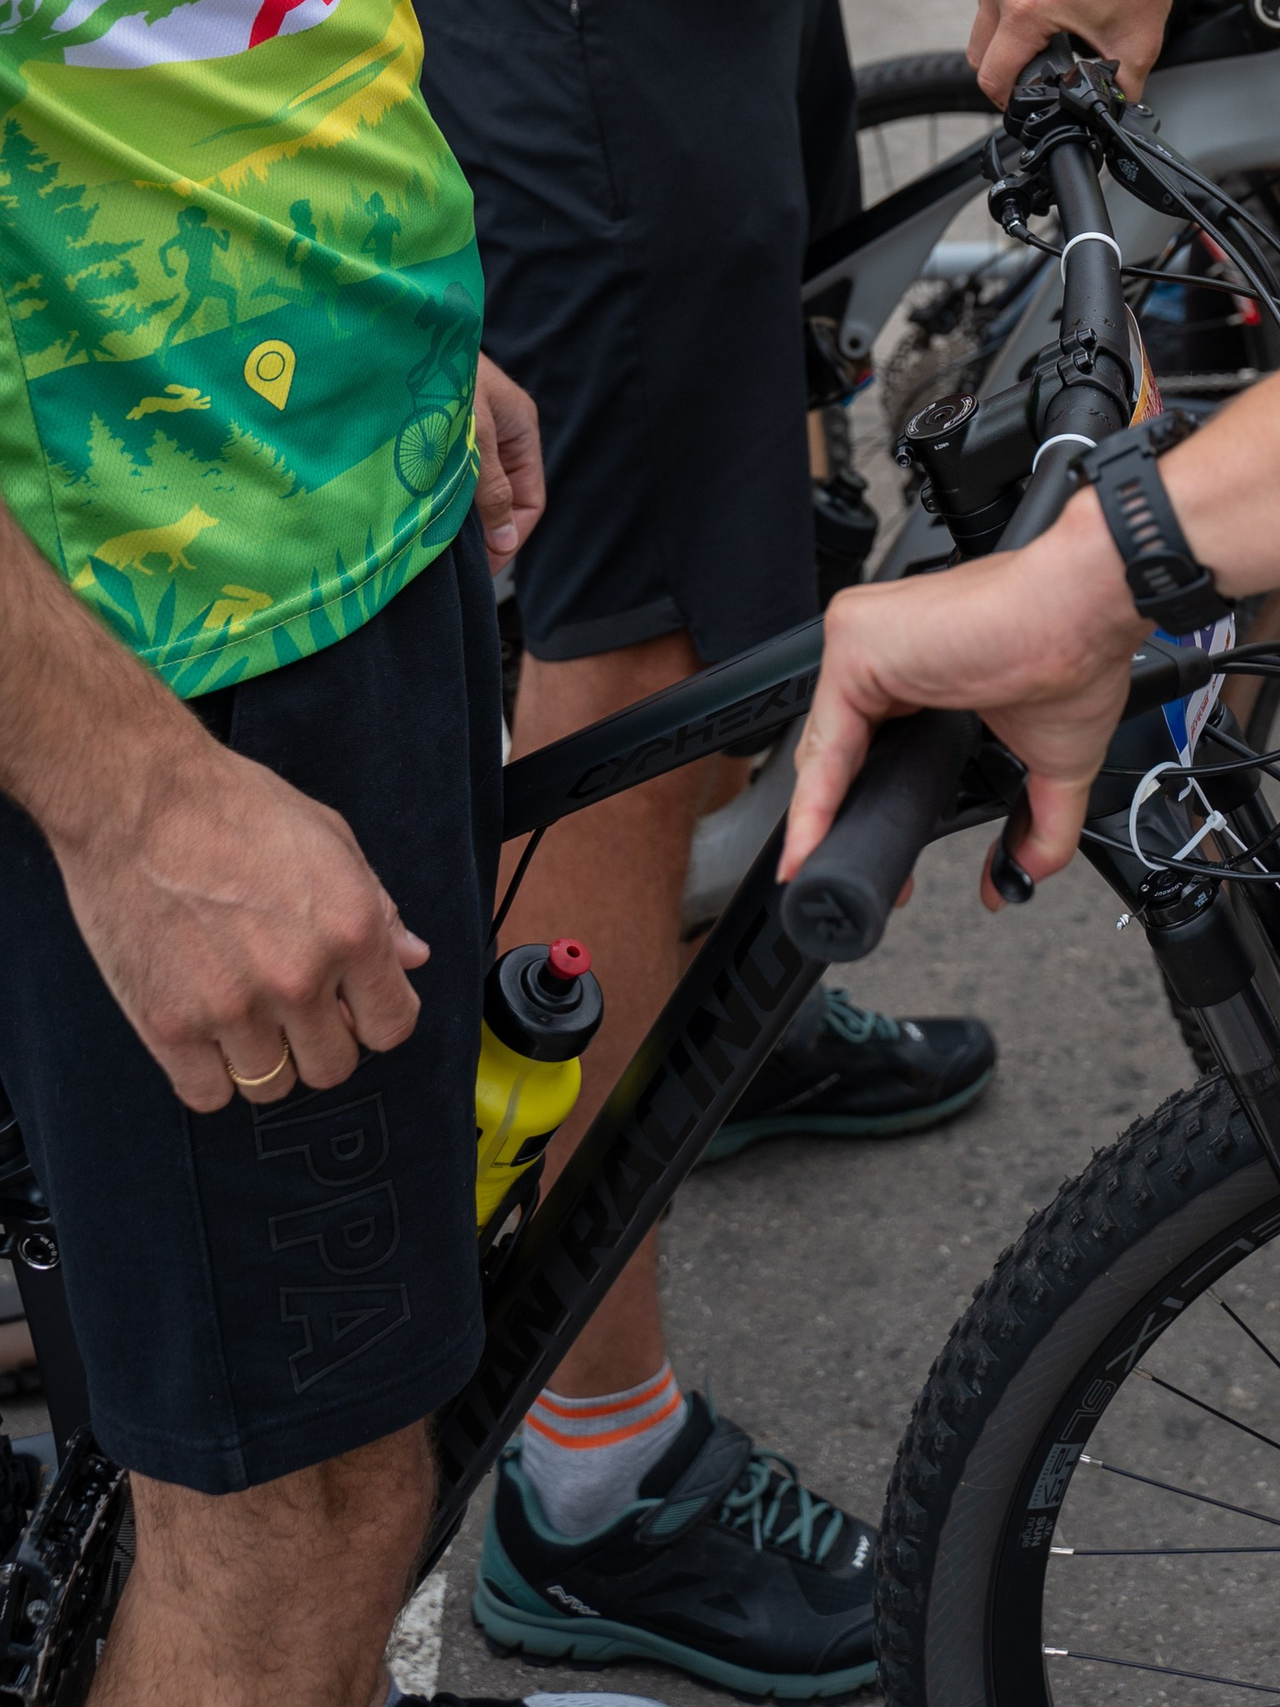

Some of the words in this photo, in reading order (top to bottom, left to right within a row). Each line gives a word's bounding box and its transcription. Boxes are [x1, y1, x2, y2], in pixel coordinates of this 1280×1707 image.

[1153, 882, 1183, 897] LOCKOUT
[556, 906, 803, 1286] RACING
[251, 1088, 411, 1395] PPA
[1061, 1379, 1117, 1441] SL
[1031, 1516, 1047, 1547] SUN
